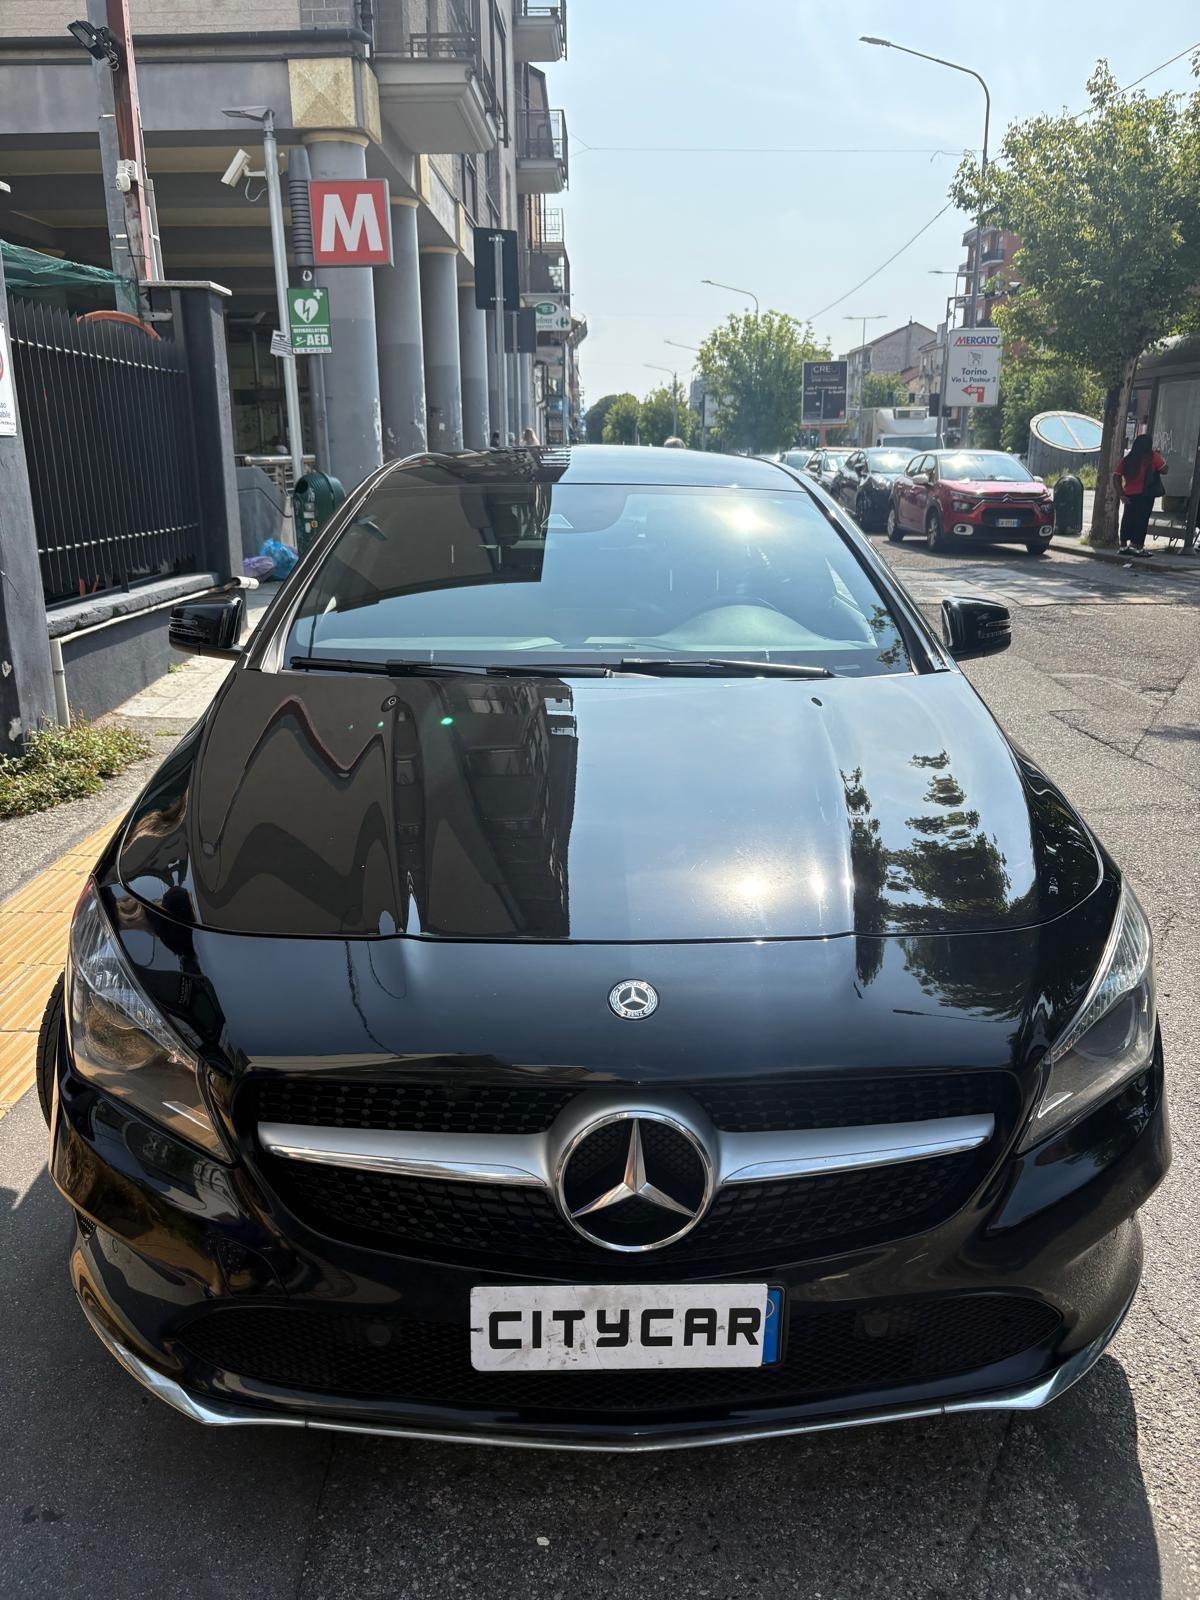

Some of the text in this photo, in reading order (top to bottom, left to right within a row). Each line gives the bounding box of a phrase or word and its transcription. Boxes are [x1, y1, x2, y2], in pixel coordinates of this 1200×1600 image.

[320, 193, 384, 252] M
[307, 334, 329, 345] AED
[962, 367, 987, 376] Torino
[488, 1307, 762, 1350] CITYCAR
